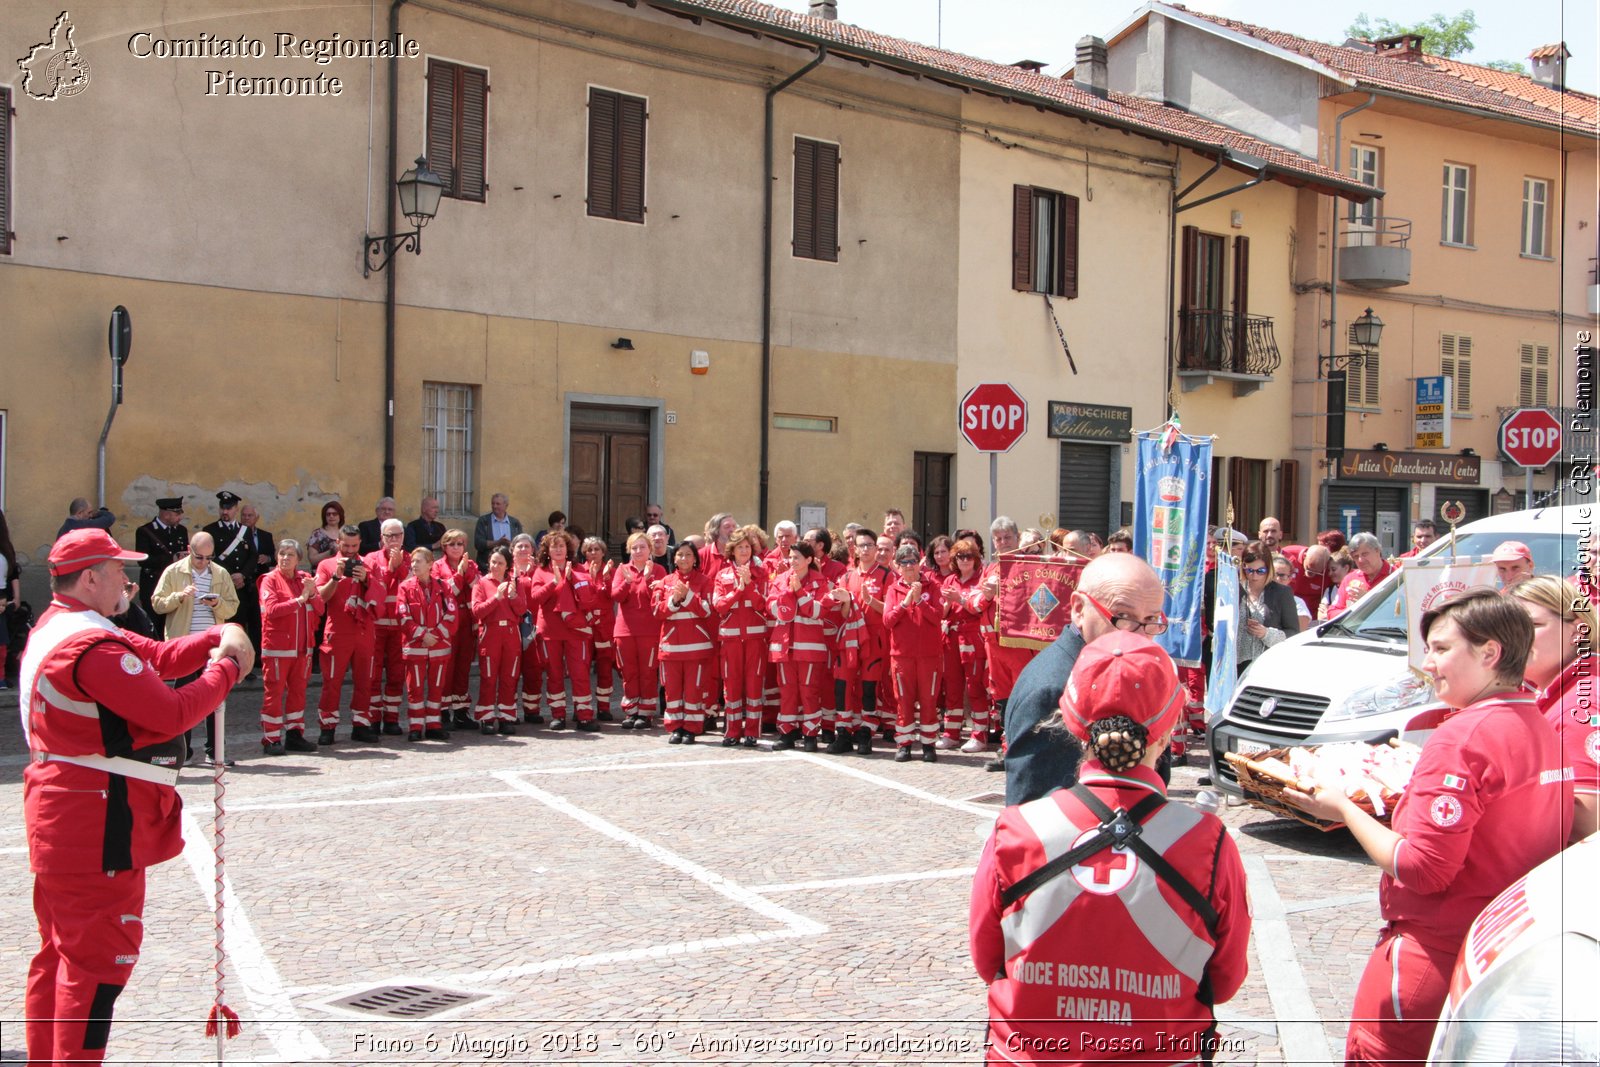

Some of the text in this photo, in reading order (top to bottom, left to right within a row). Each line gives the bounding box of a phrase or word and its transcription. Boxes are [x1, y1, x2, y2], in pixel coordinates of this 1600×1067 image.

[1423, 379, 1437, 395] T
[966, 405, 1022, 430] STOP
[1053, 404, 1128, 420] PARRUCCHIERE
[1053, 419, 1112, 437] Gilberto
[1507, 427, 1559, 448] STOP
[1343, 453, 1477, 480] Antica Tabaccheria del Centro
[1431, 581, 1454, 594] ROSSA
[1030, 627, 1055, 637] FIANO
[1013, 962, 1181, 999] CROCE ROSSA ITALIANA
[1056, 996, 1132, 1026] FANFARA
